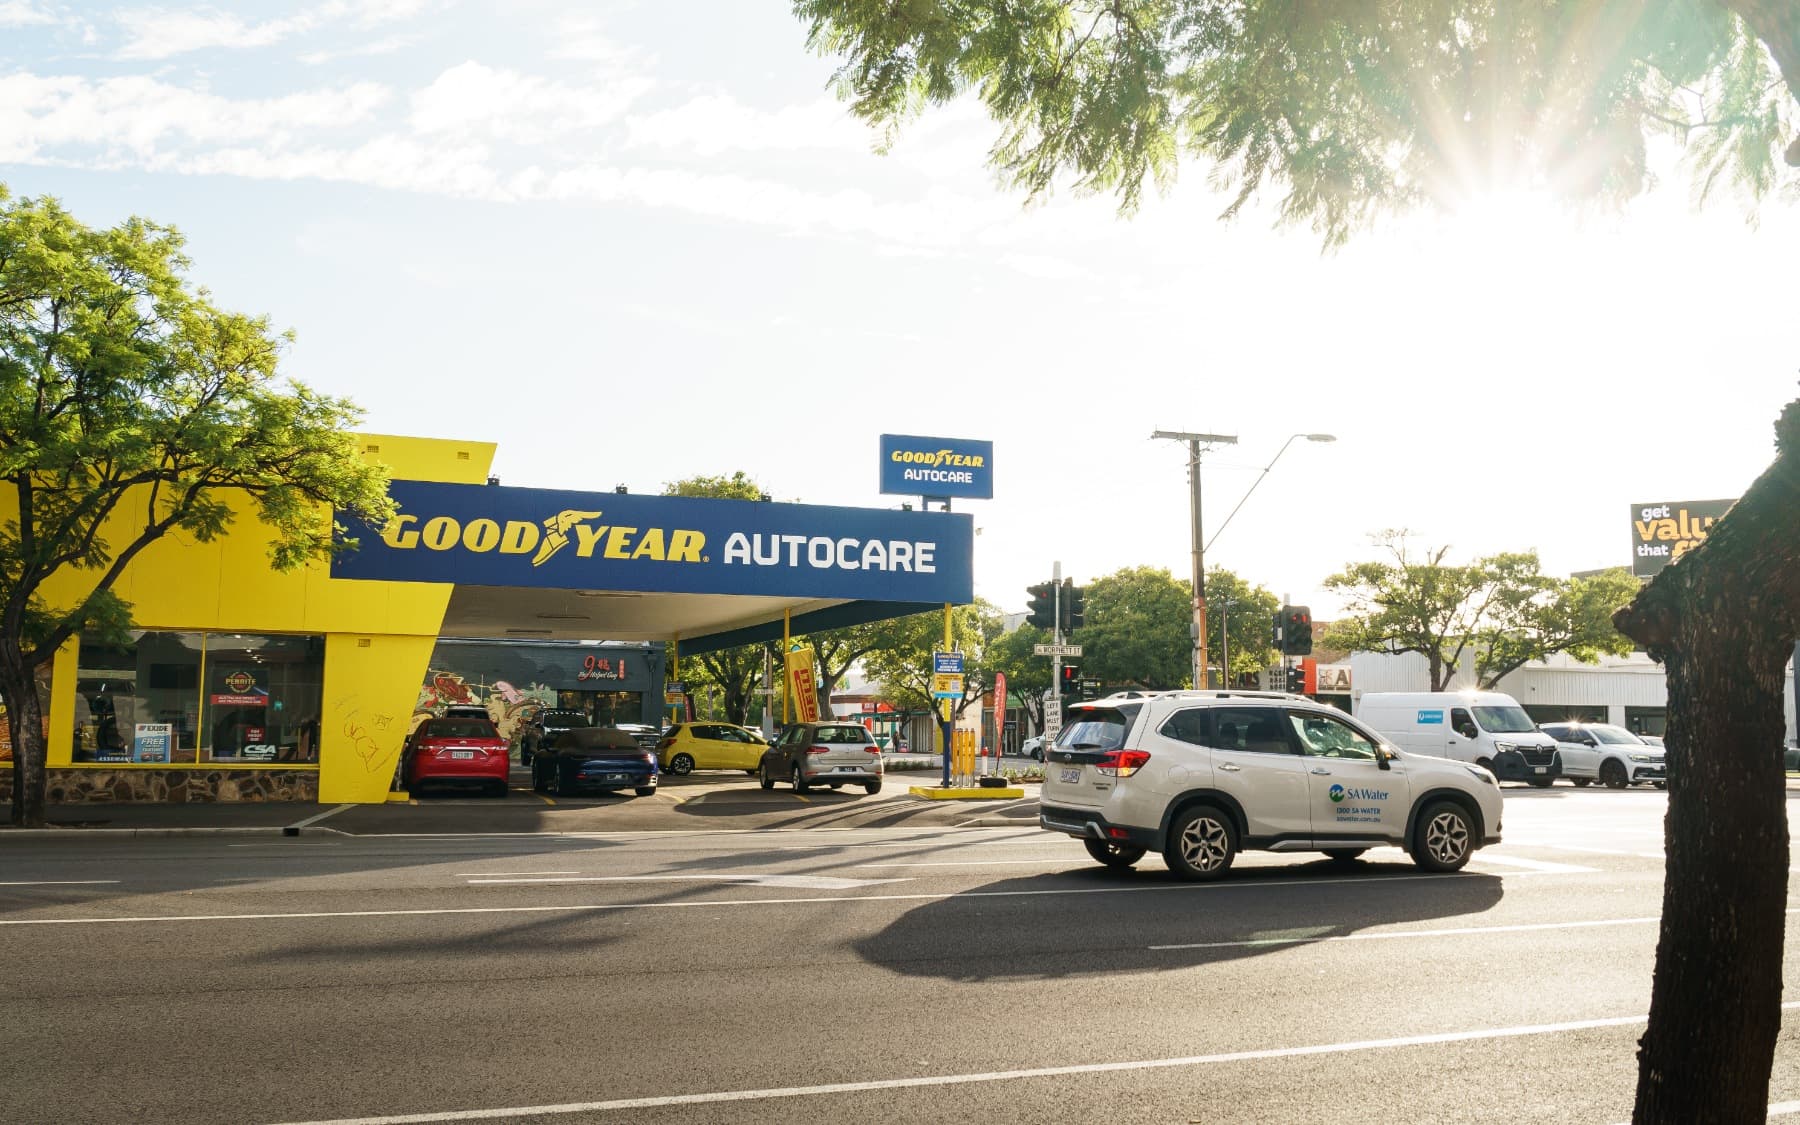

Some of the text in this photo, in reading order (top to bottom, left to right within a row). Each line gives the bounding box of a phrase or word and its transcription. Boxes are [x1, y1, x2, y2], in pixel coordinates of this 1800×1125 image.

[891, 450, 983, 467] GOODYEAR
[904, 468, 973, 483] AUTOCARE
[1641, 504, 1671, 522] get
[1635, 509, 1713, 541] valu
[724, 532, 936, 573] AUTOCARE
[1637, 544, 1669, 557] that
[244, 744, 277, 754] CSA
[1347, 788, 1389, 801] SA Water
[1360, 807, 1381, 815] WATER
